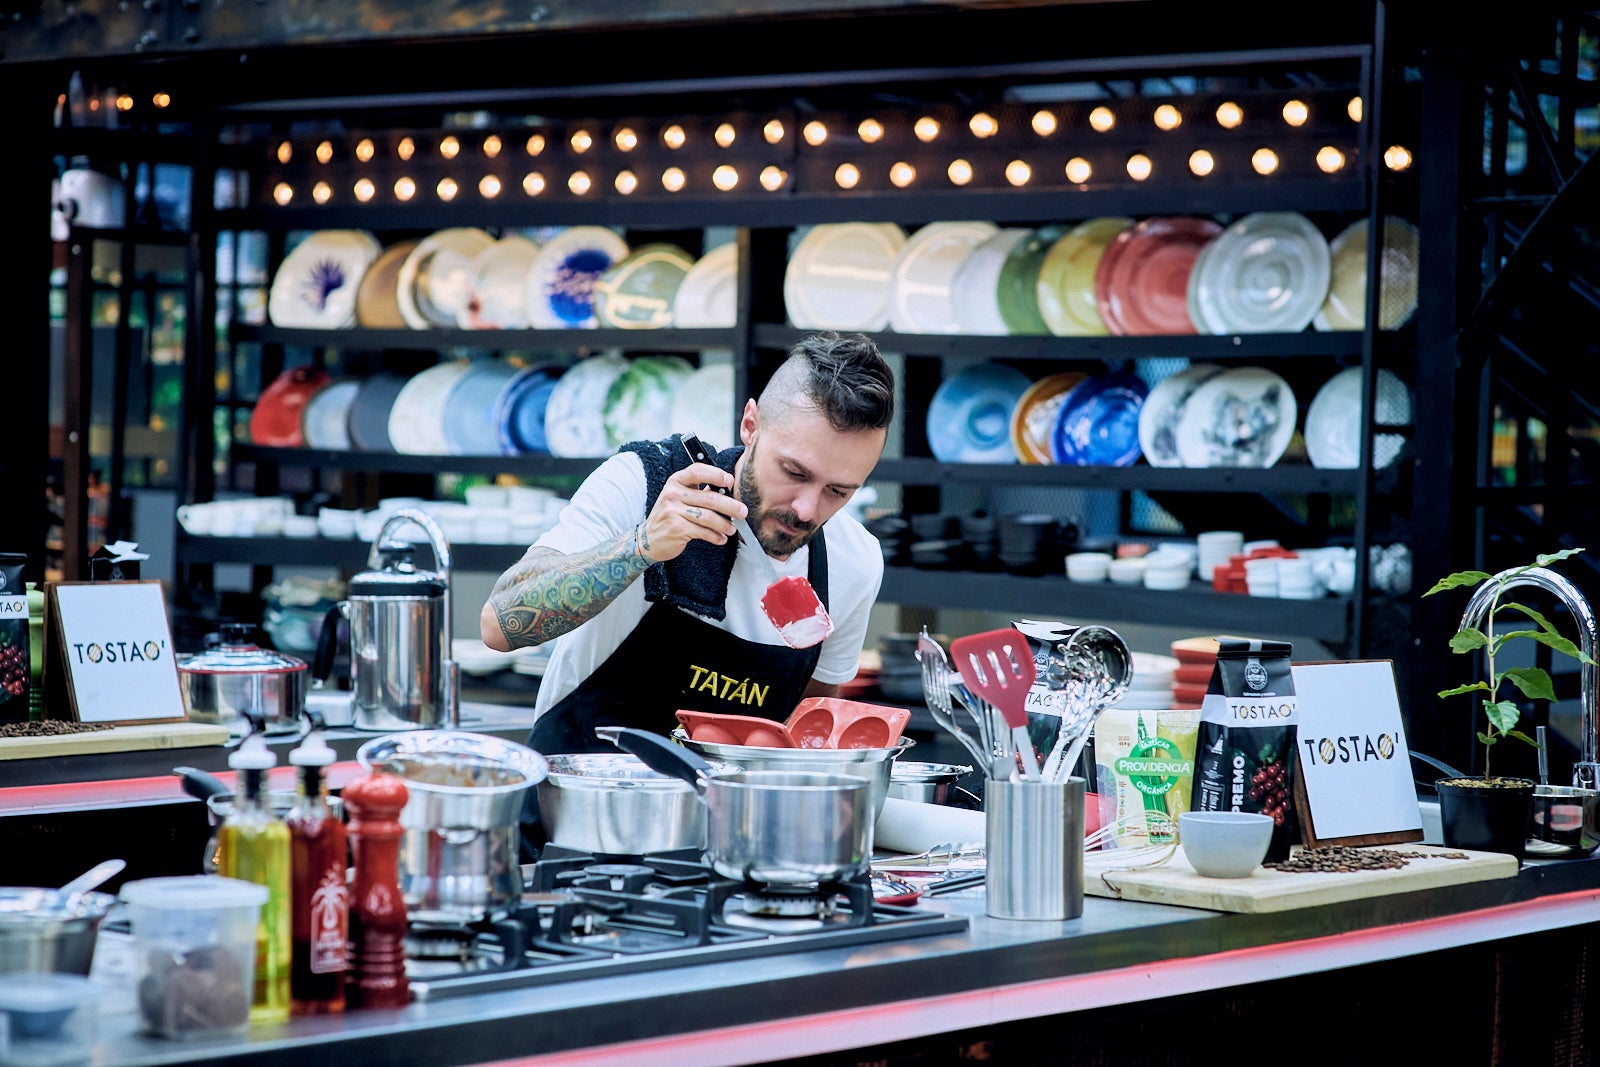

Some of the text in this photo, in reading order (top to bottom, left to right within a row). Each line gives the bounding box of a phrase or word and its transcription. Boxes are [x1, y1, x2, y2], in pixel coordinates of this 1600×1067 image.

[74, 641, 165, 664] TOSTAO'
[690, 664, 770, 707] TATÁN
[1231, 703, 1296, 719] TOSTAO'
[1304, 732, 1399, 765] TOSTAO'
[1119, 760, 1191, 773] PROVIDENCIA
[1136, 781, 1173, 795] ORGÁNICA
